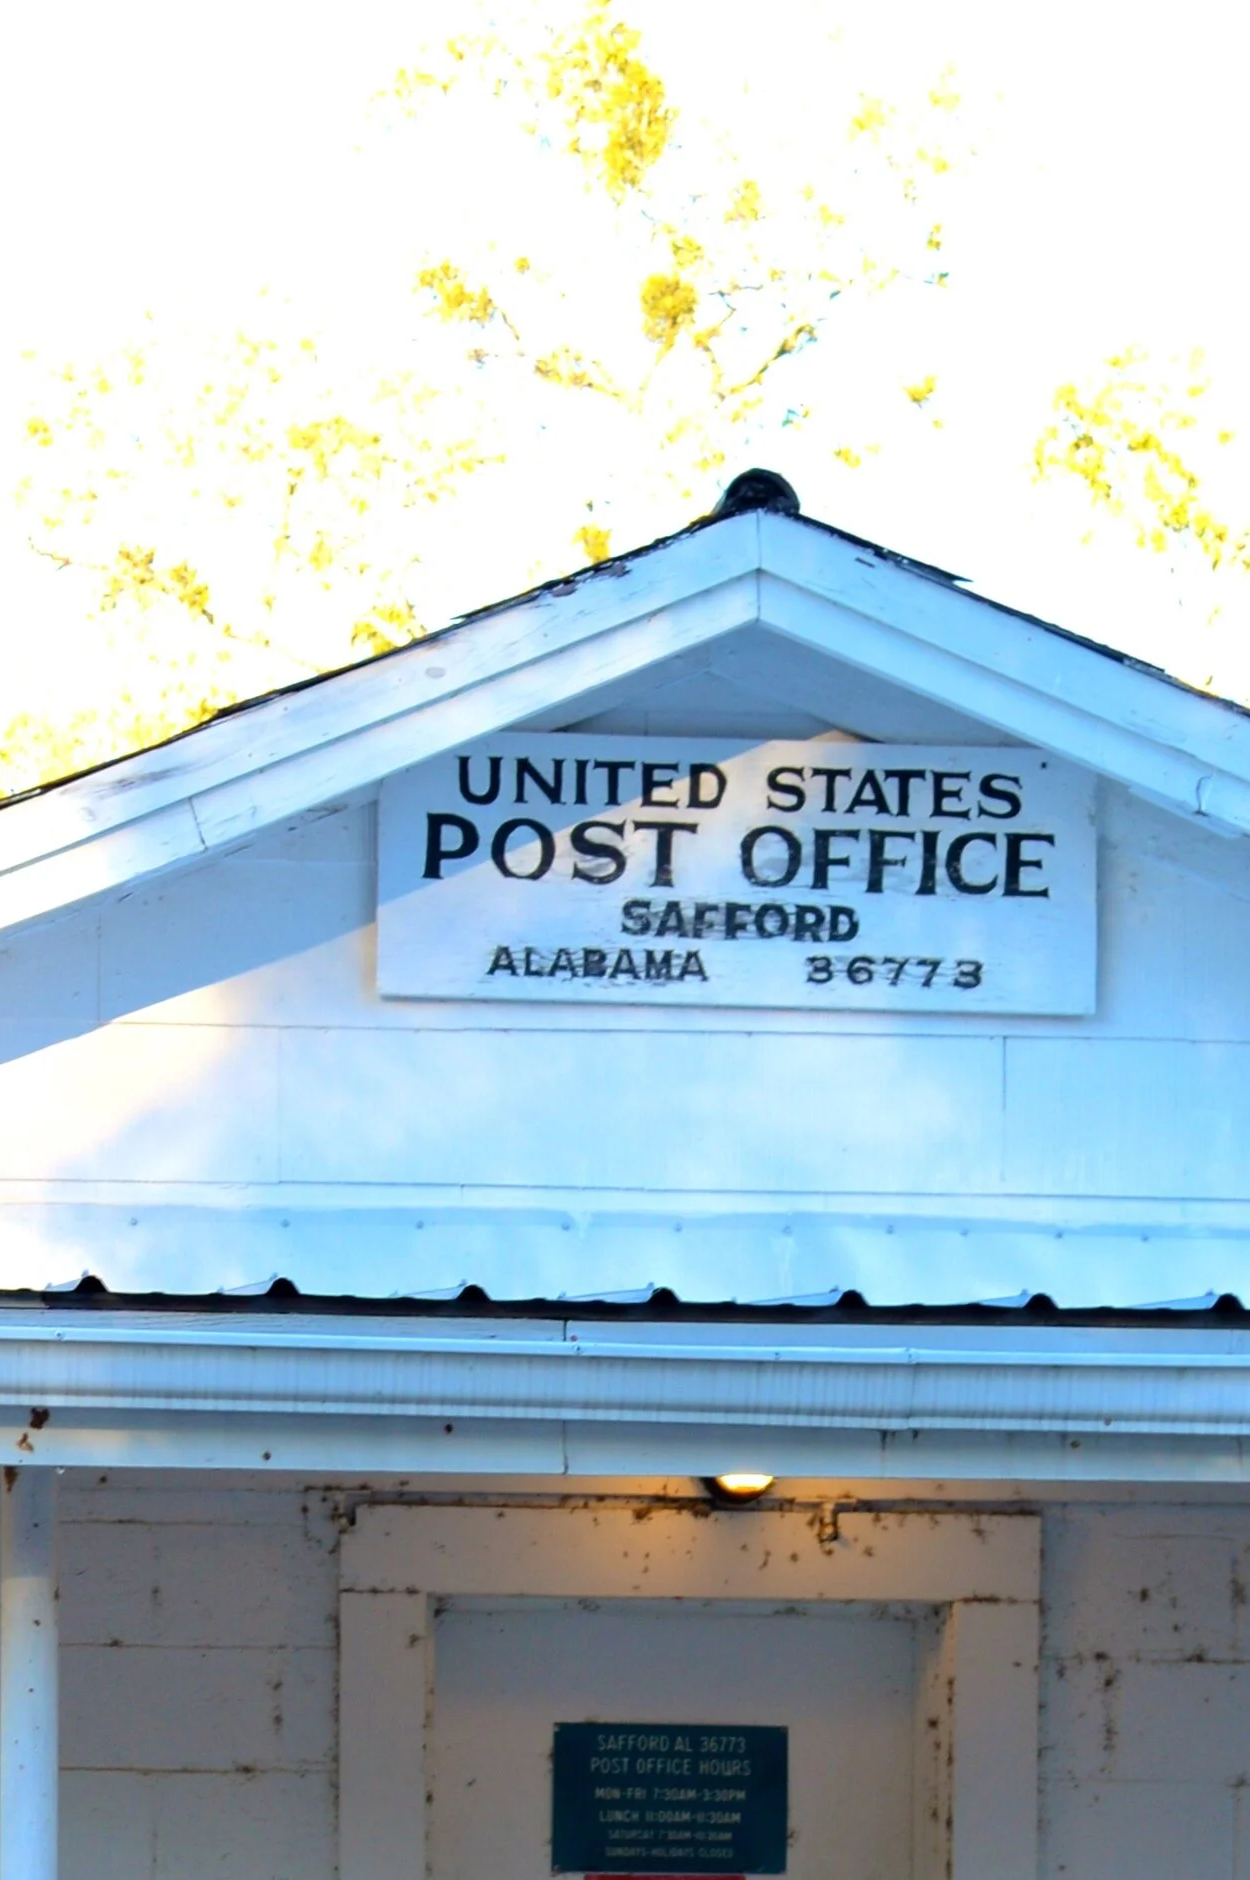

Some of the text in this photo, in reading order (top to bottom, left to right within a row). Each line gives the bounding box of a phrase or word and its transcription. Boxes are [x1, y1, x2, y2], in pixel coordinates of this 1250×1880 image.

[455, 755, 1023, 819] UNITED STATES
[421, 812, 1056, 898] POST OFFICE
[620, 899, 860, 943] SAFFORD
[485, 945, 985, 989] ALABAMA 36773
[597, 1734, 746, 1753] SAFFORD AL 36773
[590, 1757, 751, 1776] POST OFFICE HOURS
[599, 1810, 640, 1823] LUNCH
